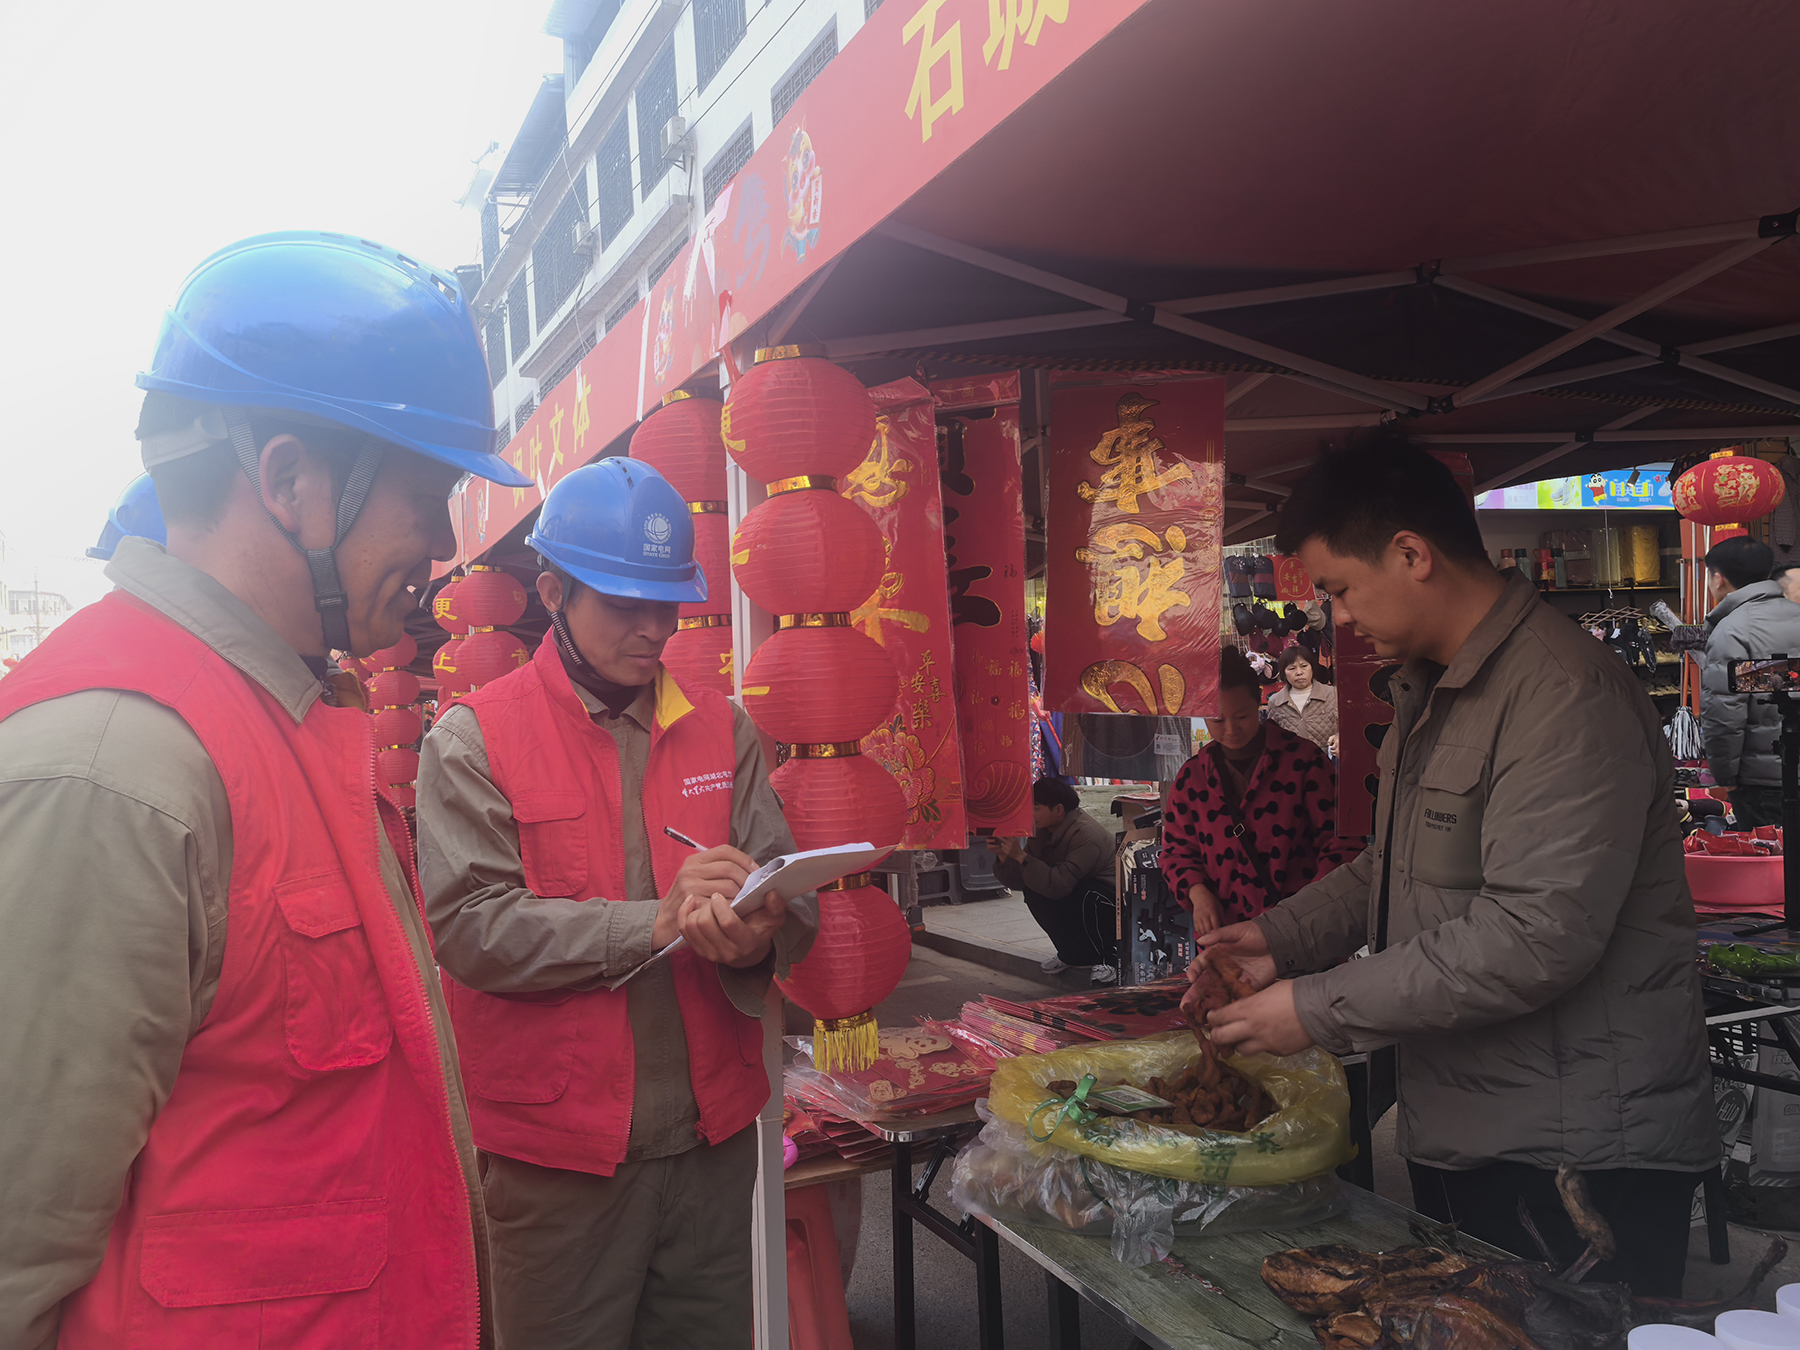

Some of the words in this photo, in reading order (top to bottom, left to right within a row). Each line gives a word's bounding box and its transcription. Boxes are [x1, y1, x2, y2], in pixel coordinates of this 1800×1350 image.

[643, 543, 671, 554] 国家电网
[1007, 660, 1023, 678] 福
